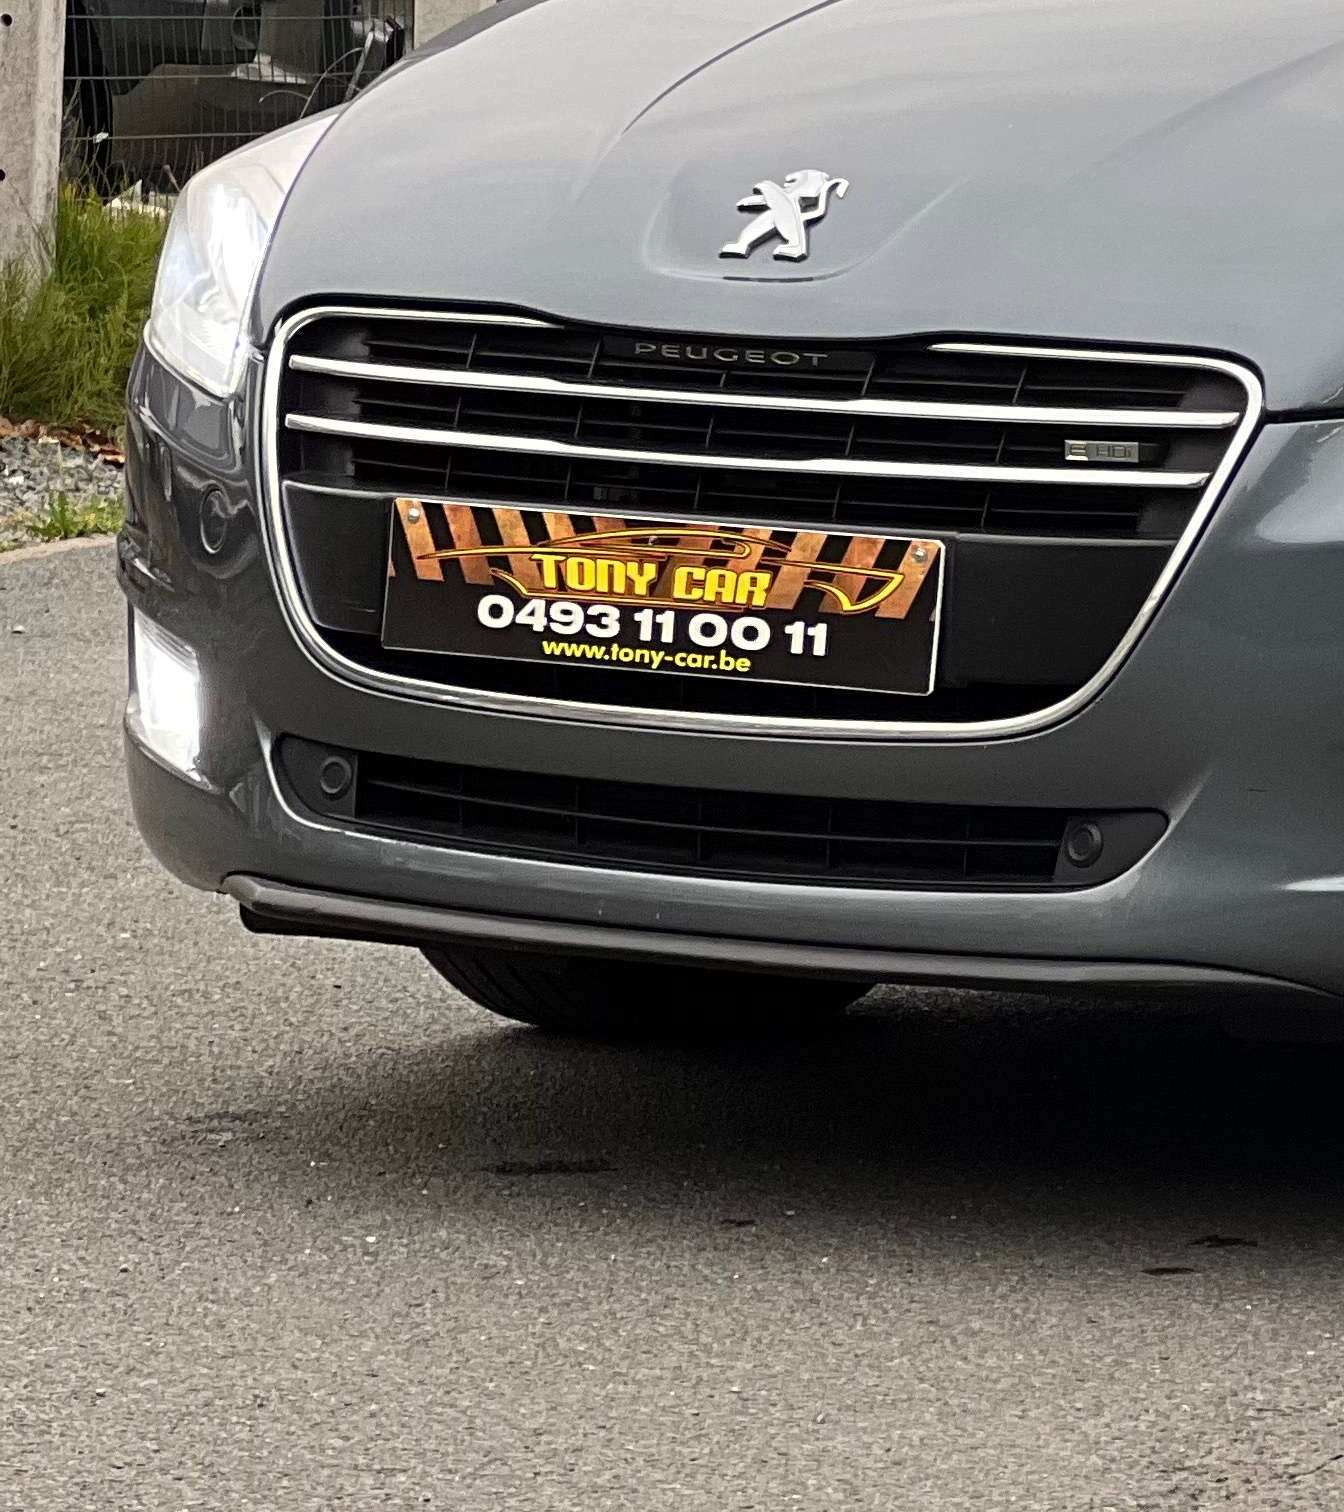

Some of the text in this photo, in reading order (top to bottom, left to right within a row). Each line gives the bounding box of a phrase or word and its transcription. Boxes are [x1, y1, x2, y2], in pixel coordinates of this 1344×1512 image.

[634, 342, 829, 367] PEUGEOT
[530, 553, 773, 609] TONY CAR
[477, 593, 828, 656] 0493 11 00 11
[542, 637, 752, 673] www.tony-car.be
